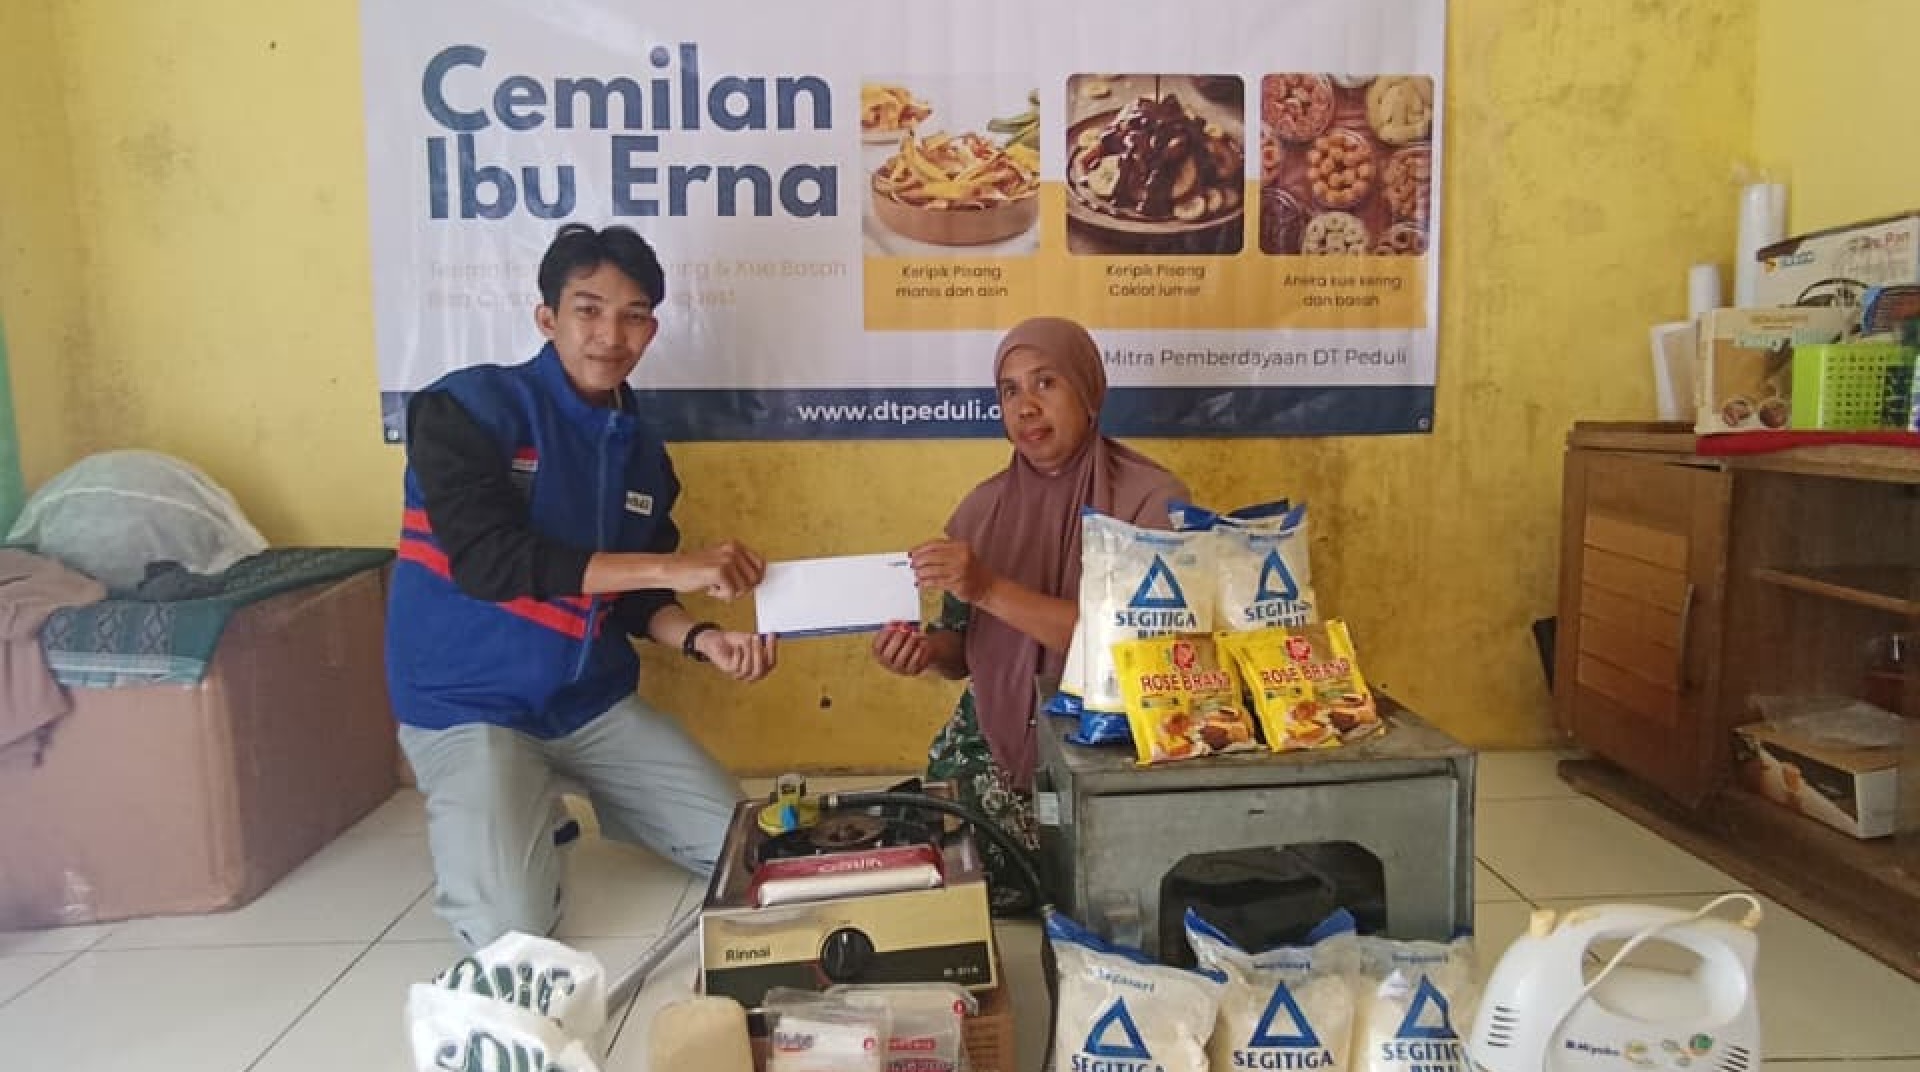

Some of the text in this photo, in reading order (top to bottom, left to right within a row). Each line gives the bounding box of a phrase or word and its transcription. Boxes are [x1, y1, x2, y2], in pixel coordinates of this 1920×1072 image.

[422, 43, 832, 131] Cemilan
[427, 135, 839, 220] Ibu Erna
[902, 264, 1001, 281] Keripik Pisang
[1106, 263, 1205, 280] Keripik Pisang
[945, 283, 974, 297] dan
[1104, 347, 1408, 370] Mitra Pemberdayaan DT Peduli
[797, 399, 1003, 424] www.dtpeduli.o
[1115, 609, 1197, 629] SEGITIGA
[1141, 673, 1180, 692] ROSE
[1261, 666, 1300, 686] ROSE
[1233, 1050, 1335, 1069] SEGITIGA
